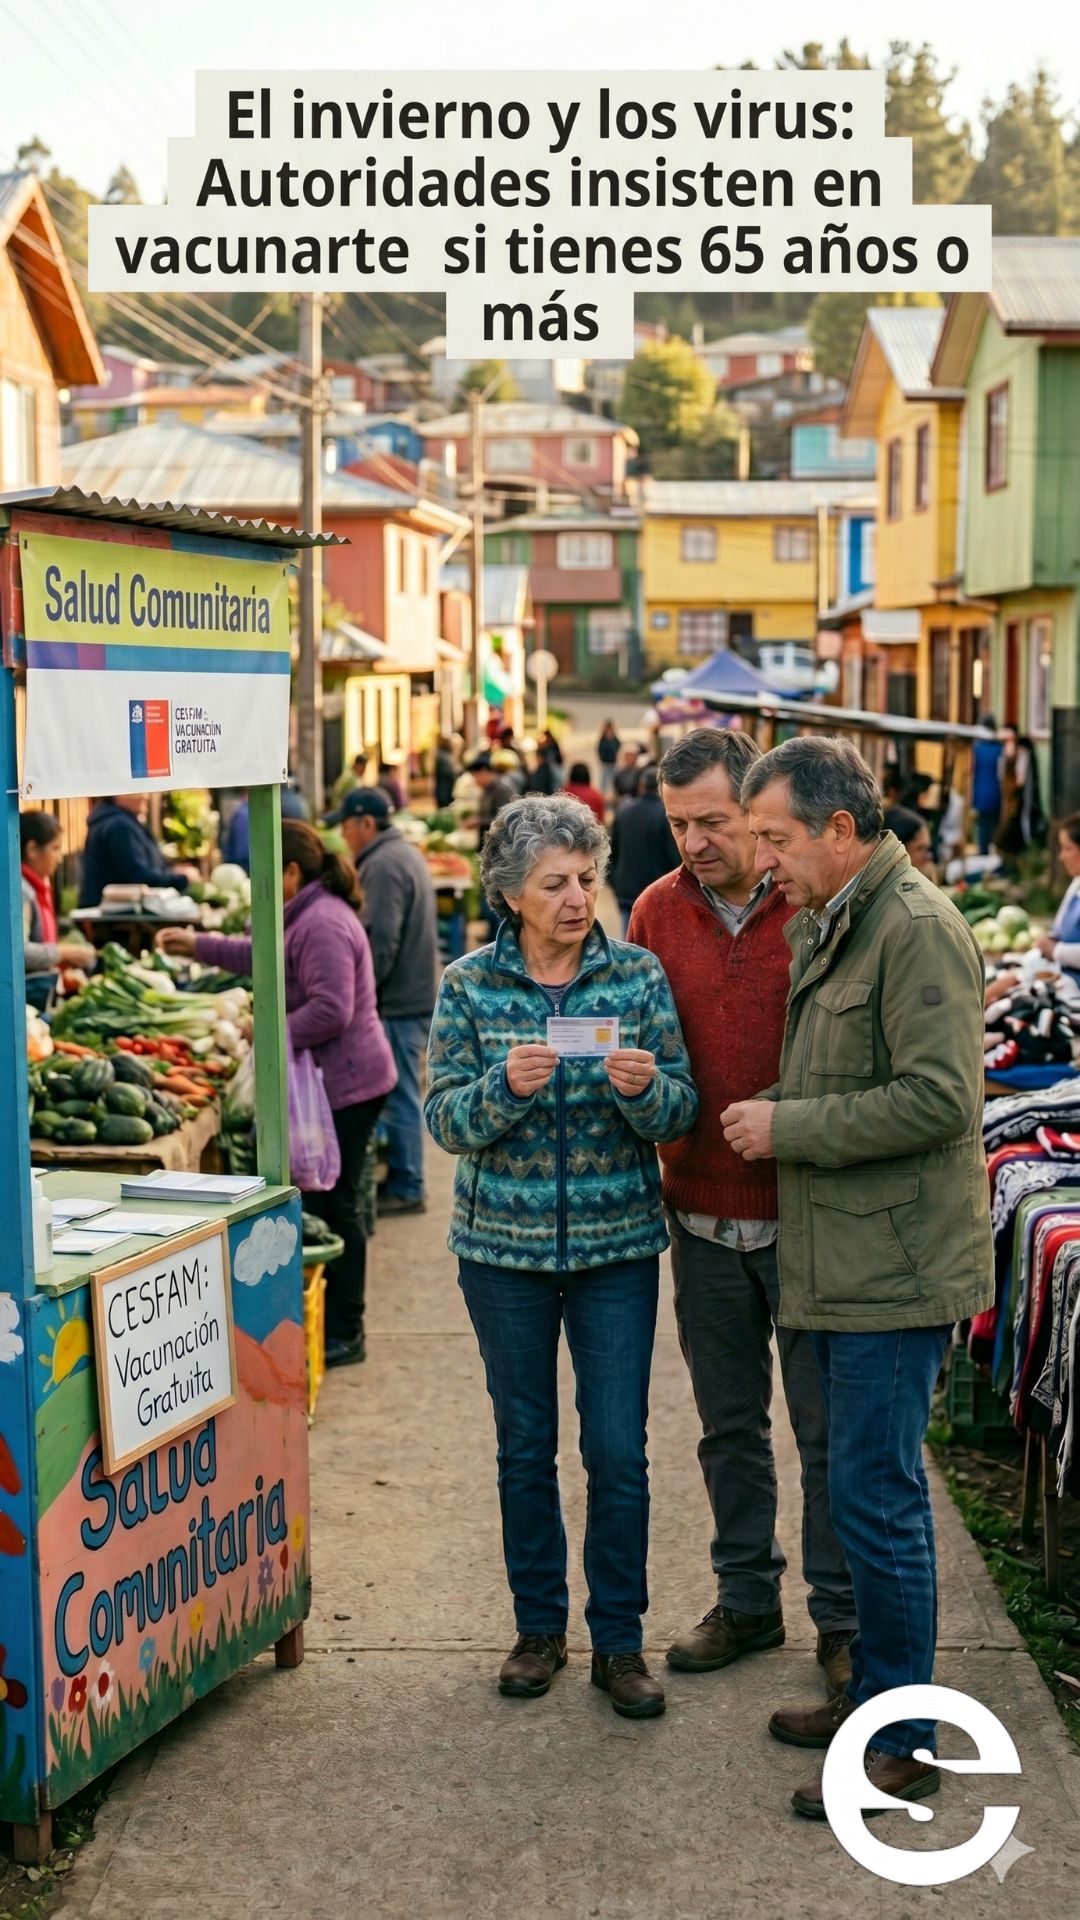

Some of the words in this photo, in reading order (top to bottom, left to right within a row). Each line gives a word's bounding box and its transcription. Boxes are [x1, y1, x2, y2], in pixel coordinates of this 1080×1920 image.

[45, 565, 120, 625] Salud
[174, 739, 217, 754] GRATUITA
[108, 1258, 209, 1339] CESFAM:
[113, 1311, 220, 1388] Vacunación
[137, 1361, 214, 1427] Gratuita
[55, 1475, 288, 1678] Comunitaria
